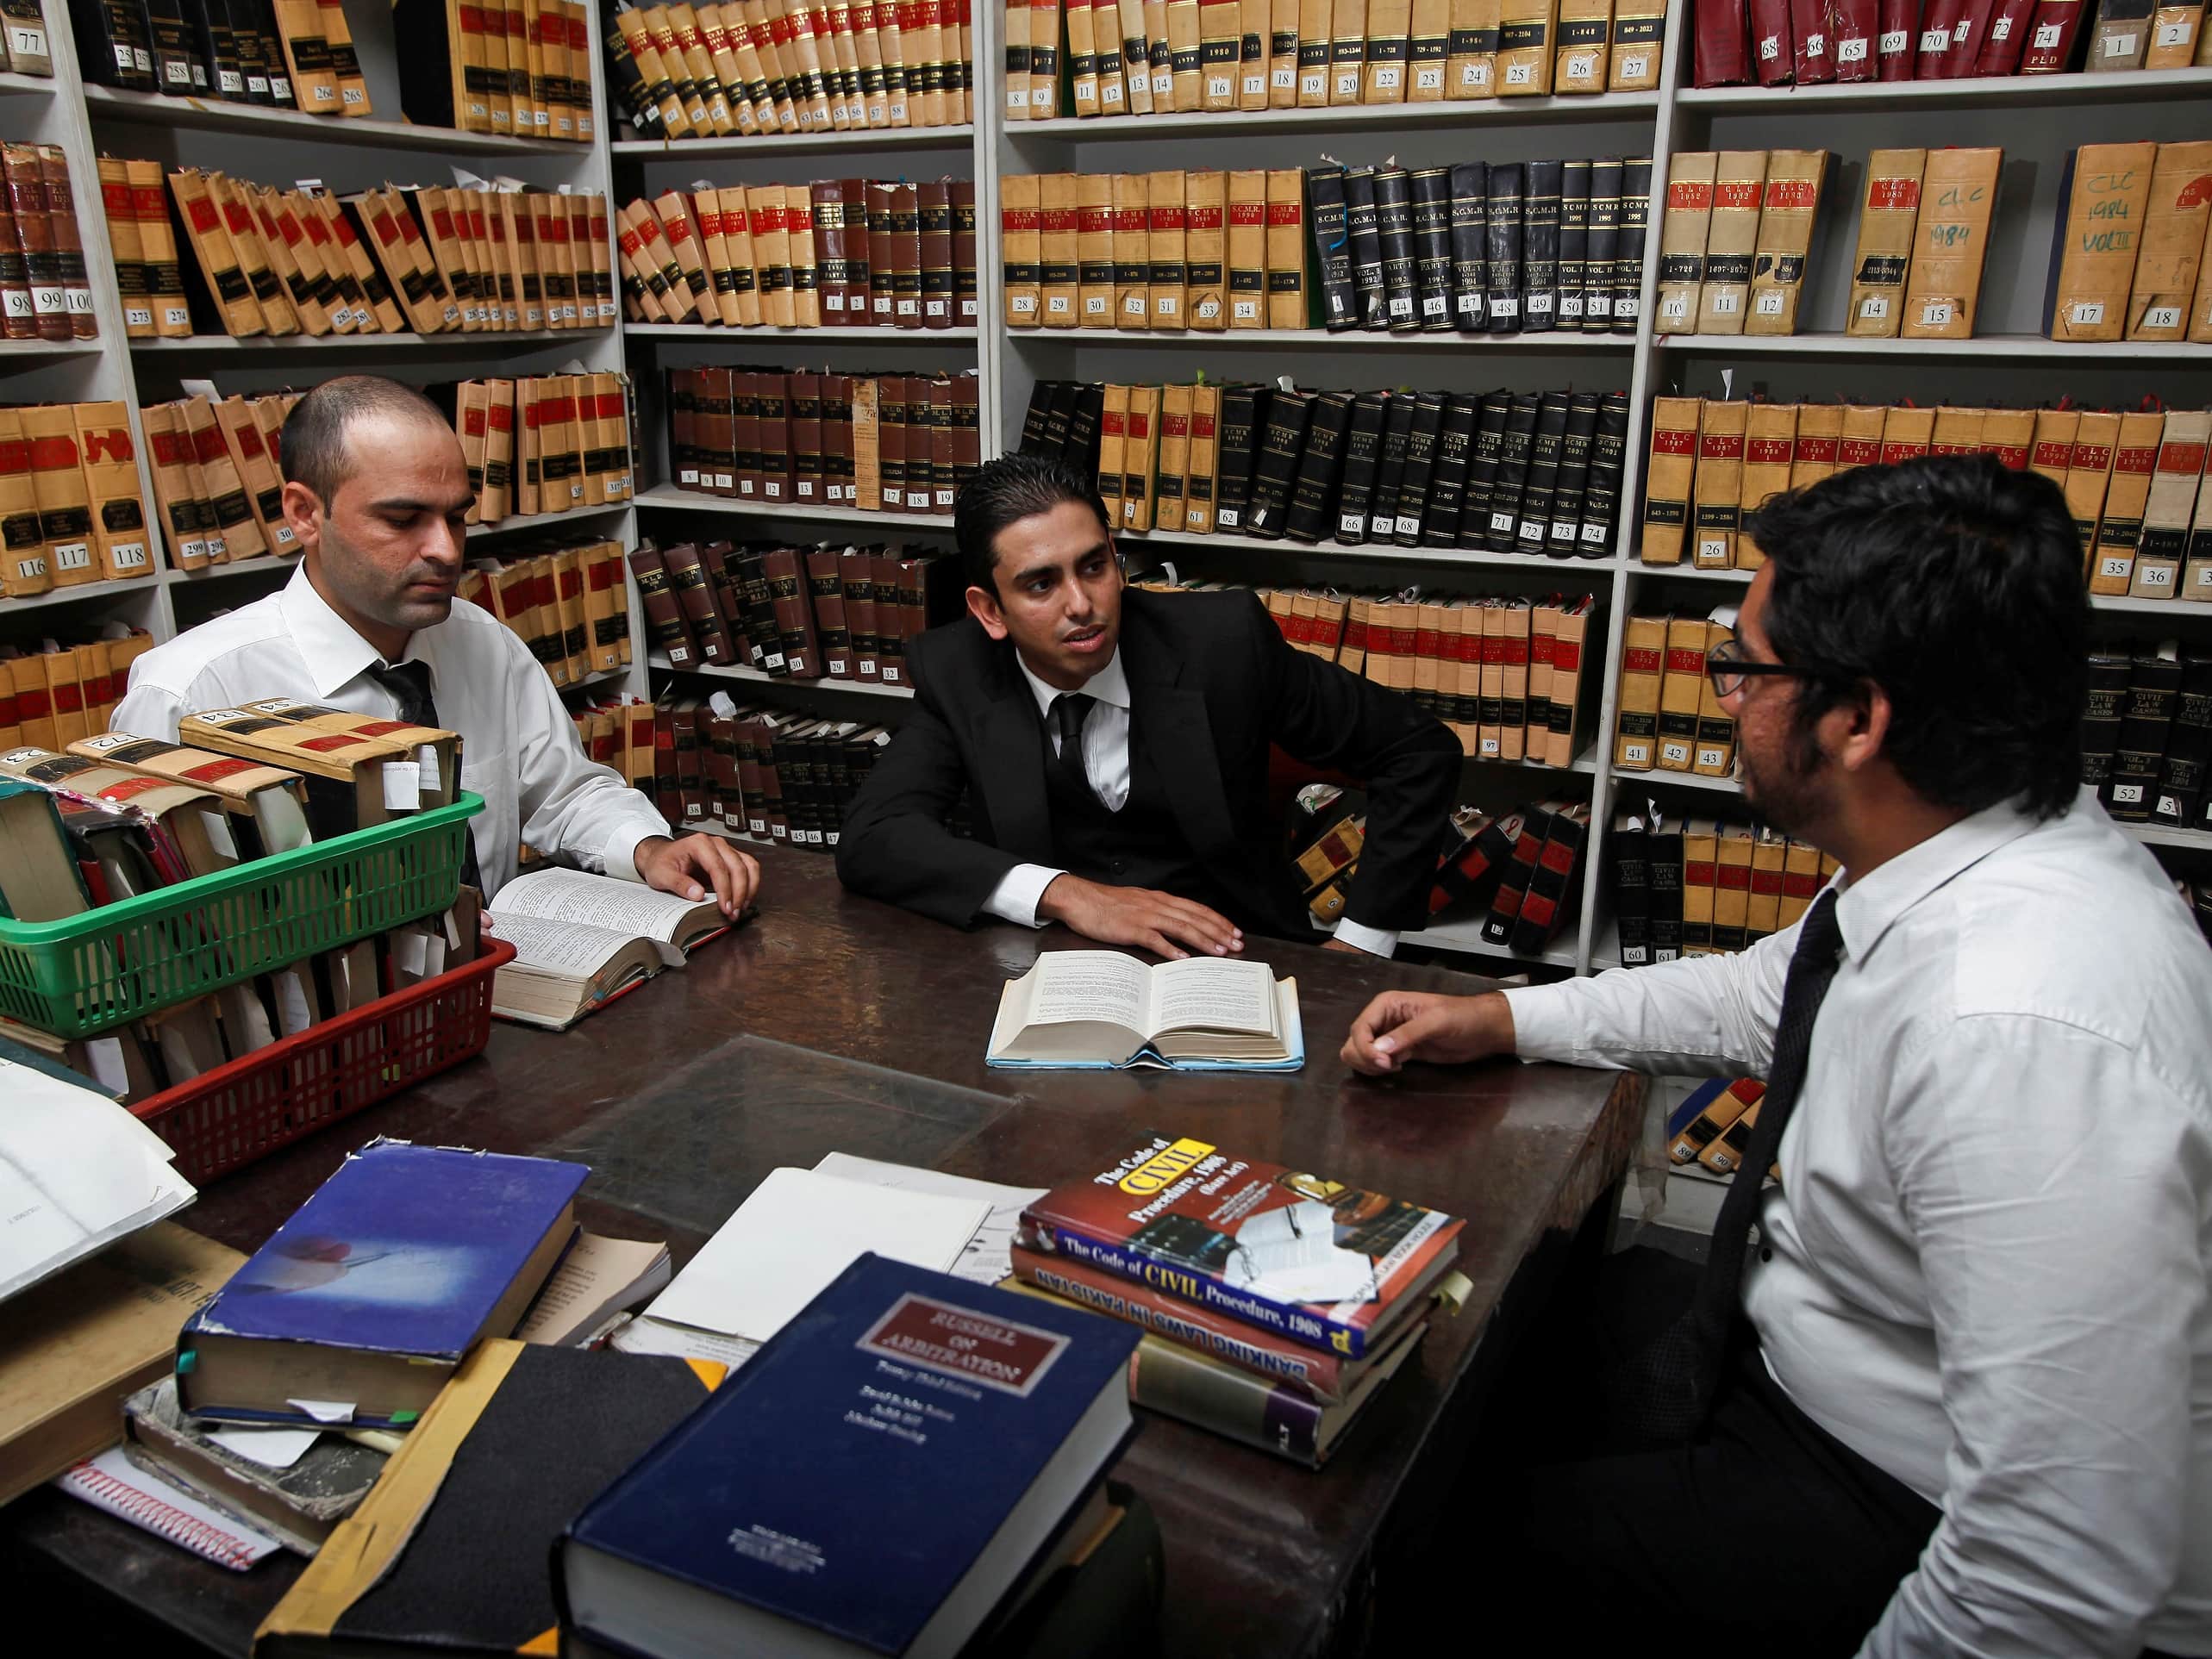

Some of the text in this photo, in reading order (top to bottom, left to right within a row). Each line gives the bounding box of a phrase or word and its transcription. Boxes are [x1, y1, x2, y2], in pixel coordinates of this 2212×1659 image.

[1996, 23, 2009, 36] 72
[19, 34, 39, 51] 77
[1884, 35, 1900, 48] 69
[1928, 35, 1941, 47] 70
[2038, 31, 2052, 44] 74
[1762, 41, 1776, 56] 68
[1808, 40, 1823, 53] 66
[1845, 44, 1860, 56] 65
[1510, 69, 1524, 80] 25
[1572, 64, 1587, 75] 26
[1628, 63, 1640, 75] 27
[1278, 73, 1289, 84] 18
[1381, 74, 1393, 84] 22
[1422, 75, 1434, 85] 23
[1467, 71, 1480, 82] 24
[1133, 79, 1143, 90] 13
[1156, 79, 1166, 90] 14
[1215, 83, 1226, 93] 16
[1248, 80, 1259, 90] 17
[1307, 80, 1318, 90] 19
[1344, 80, 1356, 90] 20
[1079, 87, 1089, 97] 11
[1107, 90, 1116, 99] 12
[13, 296, 31, 311] 98
[42, 292, 61, 309] 99
[1017, 300, 1028, 309] 28
[1053, 300, 1064, 309] 29
[1090, 301, 1101, 311] 30
[1428, 301, 1441, 311] 46
[1463, 297, 1476, 309] 47
[1533, 299, 1546, 309] 49
[1590, 301, 1603, 311] 51
[1718, 299, 1731, 310] 11
[1764, 300, 1777, 311] 12
[1129, 302, 1140, 312] 32
[1160, 302, 1171, 312] 31
[1203, 305, 1214, 315] 33
[1240, 304, 1250, 315] 34
[1395, 302, 1407, 312] 44
[1497, 303, 1511, 314] 48
[1565, 302, 1579, 312] 50
[1620, 302, 1634, 313] 52
[1669, 302, 1681, 315] 10
[1867, 302, 1881, 315] 14
[132, 313, 149, 322] 273
[172, 312, 186, 321] 274
[1930, 309, 1945, 321] 15
[2080, 309, 2096, 321] 17
[2155, 311, 2171, 324] 18
[912, 496, 923, 505] 18
[940, 493, 951, 503] 19
[1190, 512, 1199, 521] 61
[1222, 513, 1234, 523] 62
[1495, 517, 1505, 527] 71
[1346, 518, 1358, 529] 66
[1376, 521, 1389, 532] 67
[1401, 521, 1413, 532] 68
[1525, 526, 1537, 537] 72
[1558, 526, 1570, 537] 73
[1587, 527, 1600, 539] 74
[117, 547, 145, 564] 118
[1706, 545, 1720, 555] 26
[59, 548, 86, 565] 117
[19, 561, 45, 578] 116
[2108, 563, 2124, 573] 35
[2148, 571, 2164, 582] 36
[203, 712, 245, 720] 134
[92, 734, 140, 747] 172
[7, 749, 41, 763] 23
[1628, 749, 1640, 758] 41
[1668, 748, 1681, 758] 42
[1703, 753, 1716, 763] 43
[2120, 789, 2134, 800] 52
[1094, 1138, 1172, 1185] The Code of
[1127, 1149, 1204, 1190] CIVIL
[1128, 1176, 1205, 1224] Procedure,
[1193, 1155, 1227, 1176] 1908
[1065, 1236, 1322, 1338] The Code of CIVIL Procedure, 1908
[1035, 1268, 1308, 1378] BANKING LAWS IN PAKISTAN
